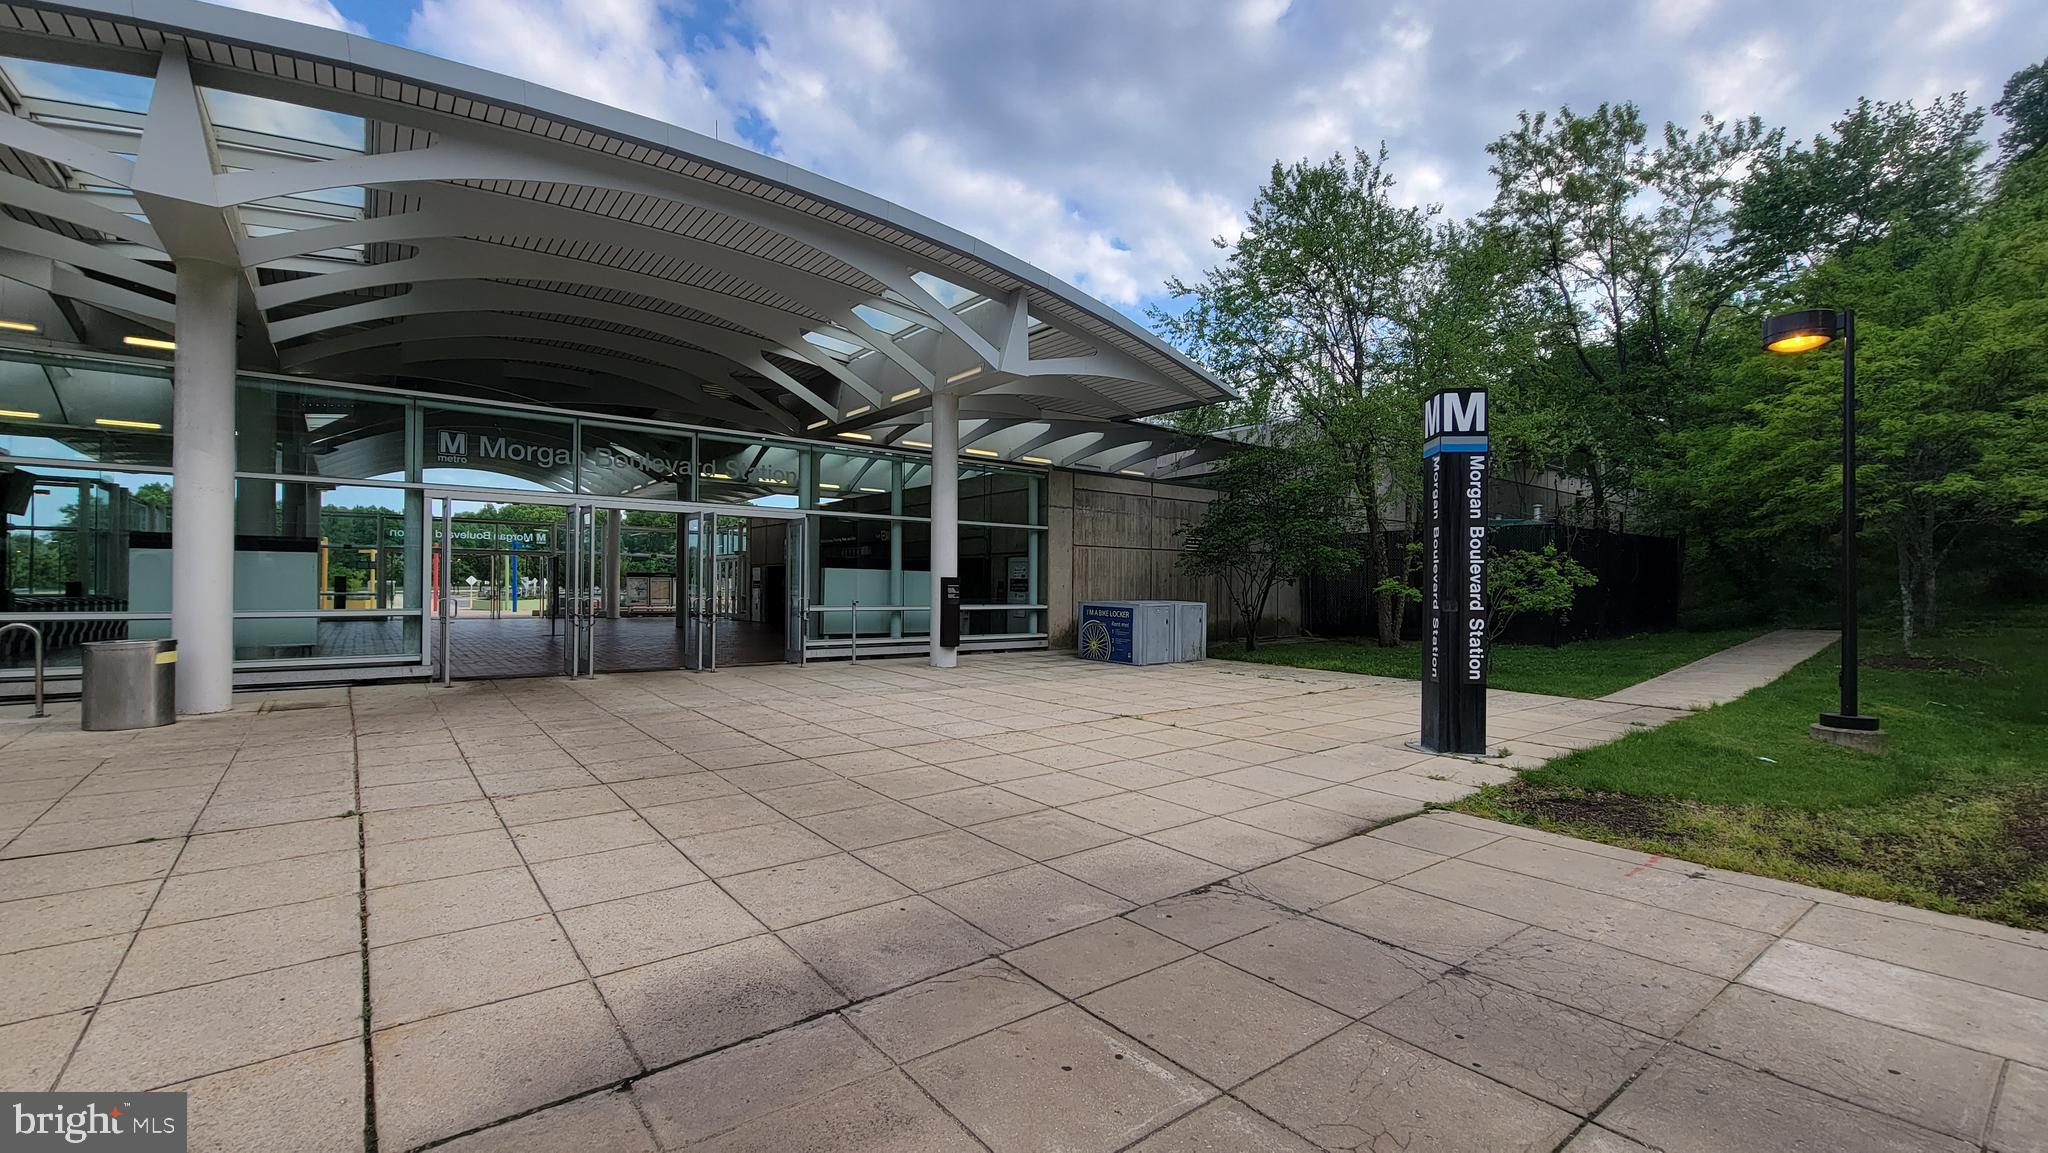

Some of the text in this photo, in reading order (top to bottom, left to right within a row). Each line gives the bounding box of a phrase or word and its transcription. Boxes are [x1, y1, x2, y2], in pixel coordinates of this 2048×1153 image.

[1425, 394, 1440, 439] M
[1443, 392, 1486, 432] M
[437, 455, 468, 464] metro
[439, 431, 466, 455] M
[596, 446, 716, 475] Boulevad
[1431, 456, 1440, 678] Morgan Boulevard Station
[1466, 455, 1485, 680] Morgan Boulevard Station
[1109, 610, 1130, 619] LOCKER
